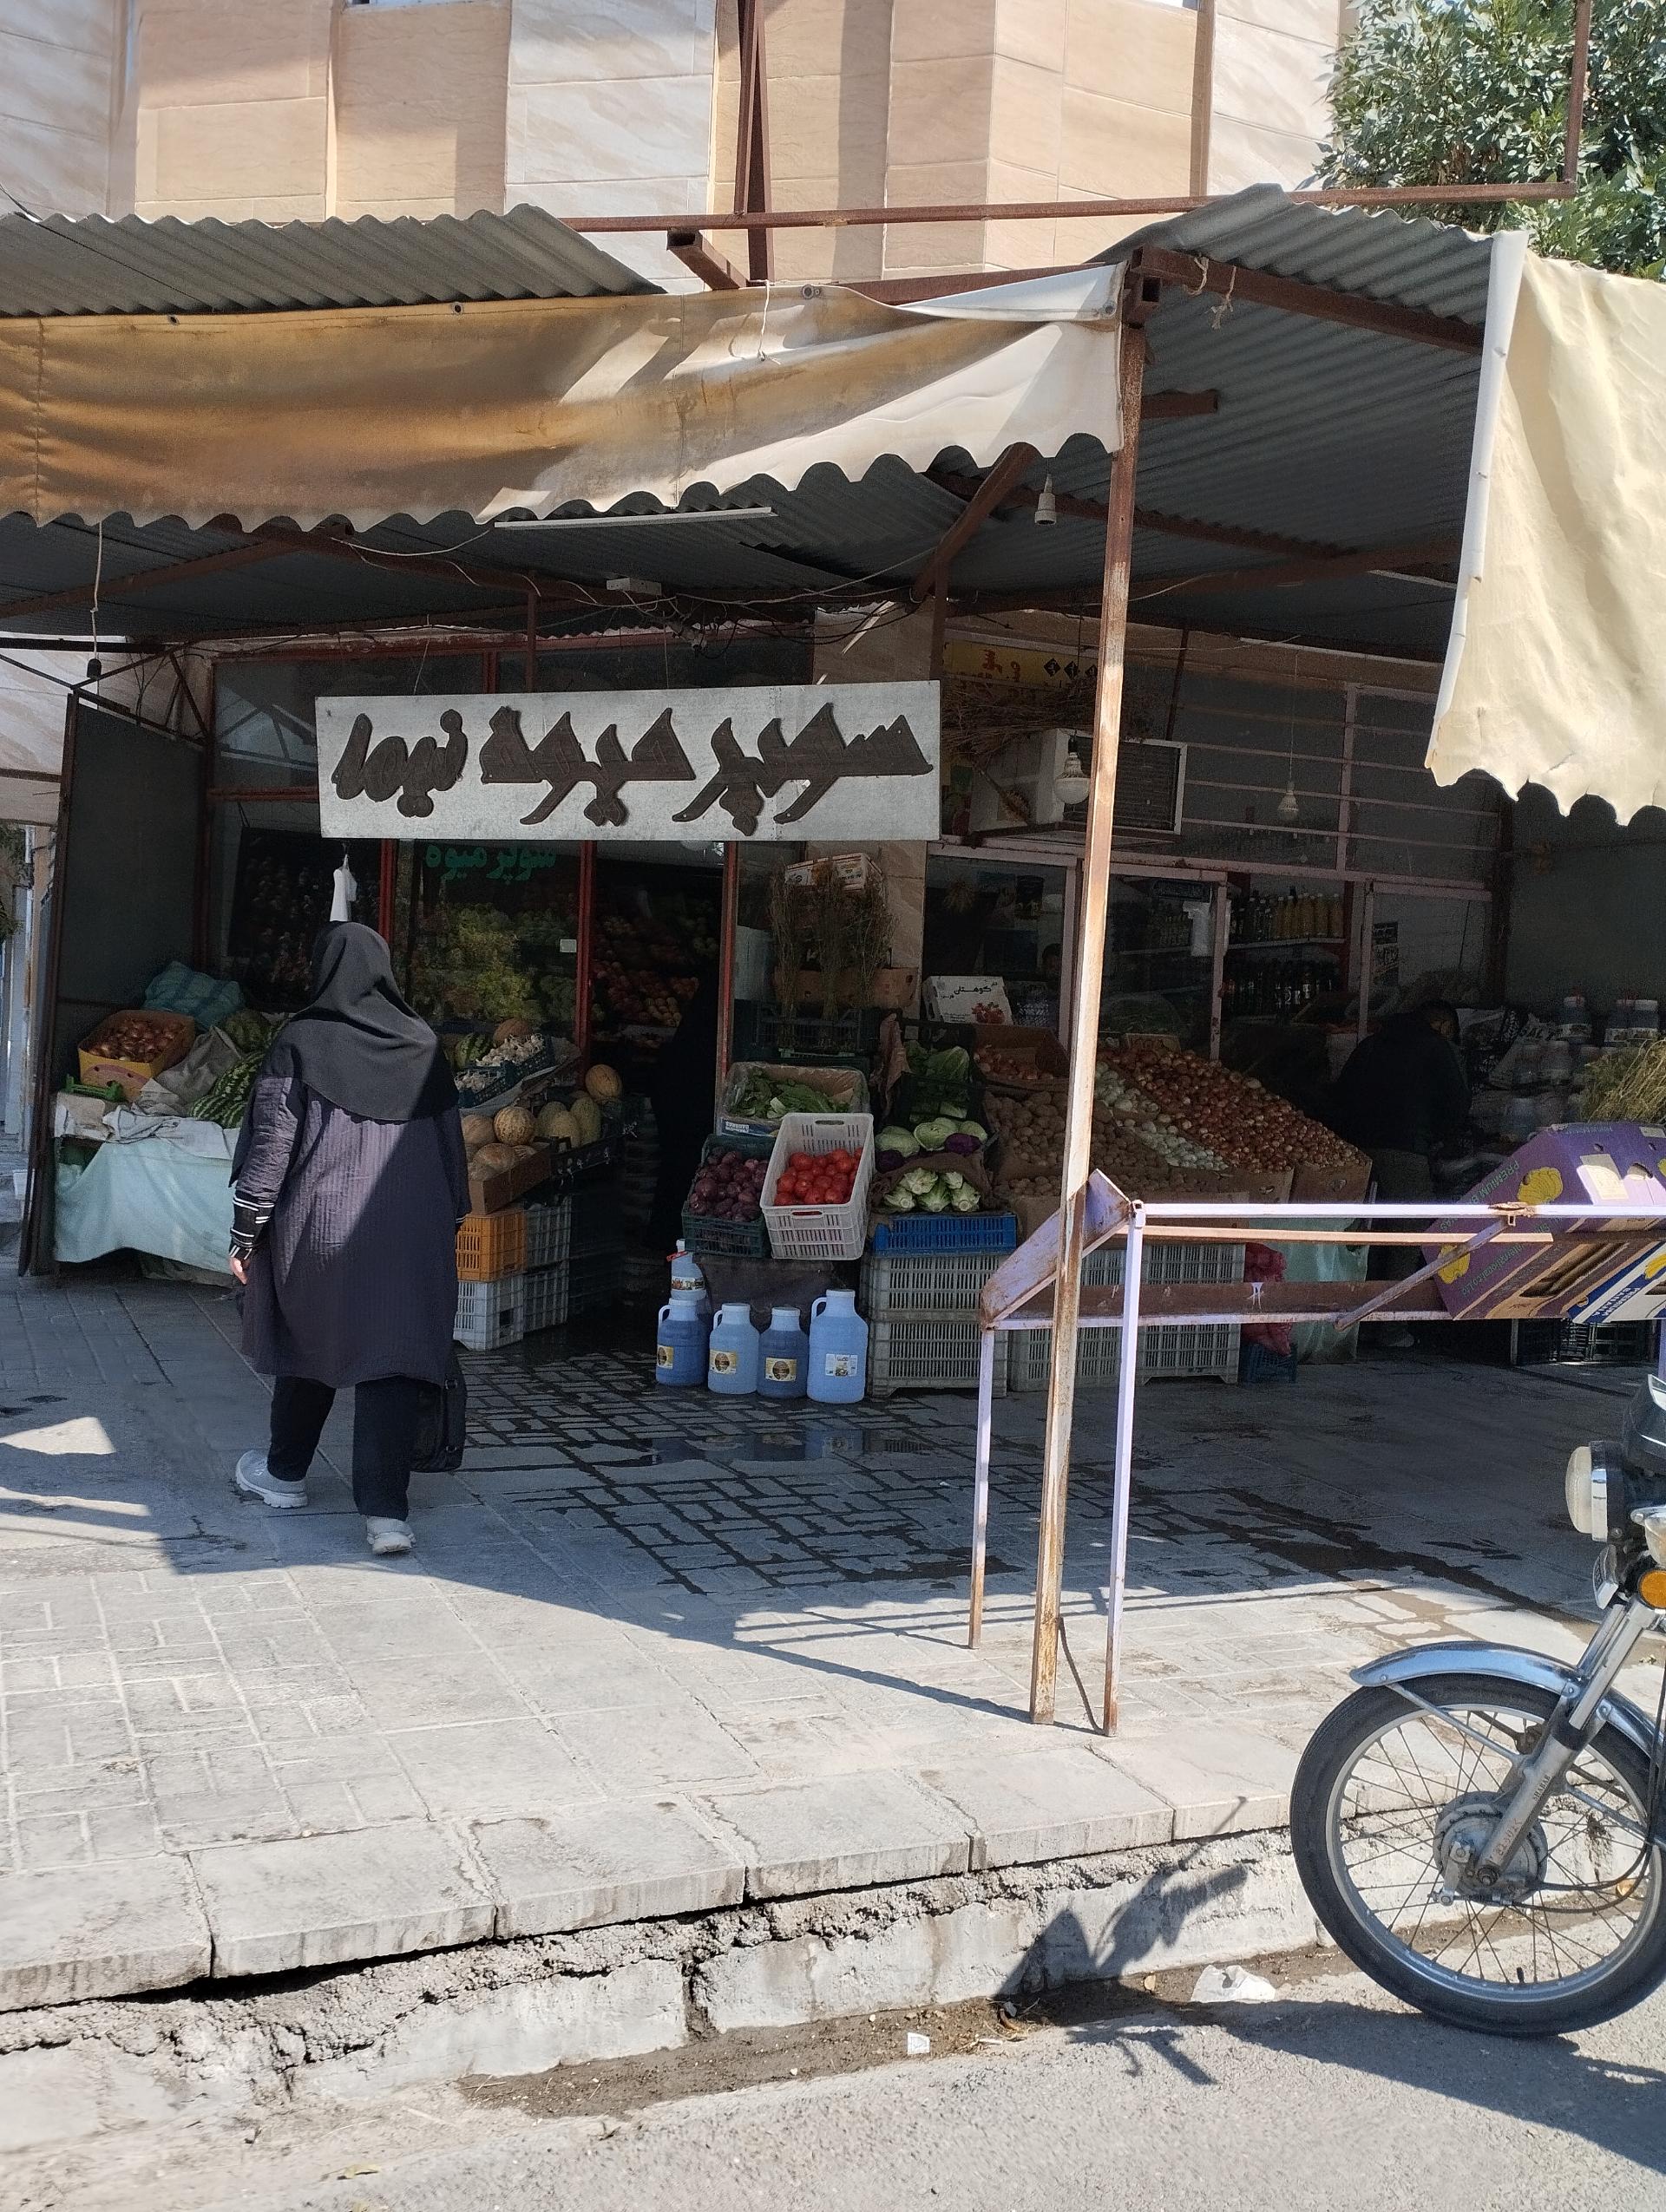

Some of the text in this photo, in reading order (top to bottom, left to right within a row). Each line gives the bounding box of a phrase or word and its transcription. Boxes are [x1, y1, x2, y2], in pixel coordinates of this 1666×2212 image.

[331, 702, 934, 836] سوپر میوه نیما
[425, 844, 556, 885] سوپر میوه
